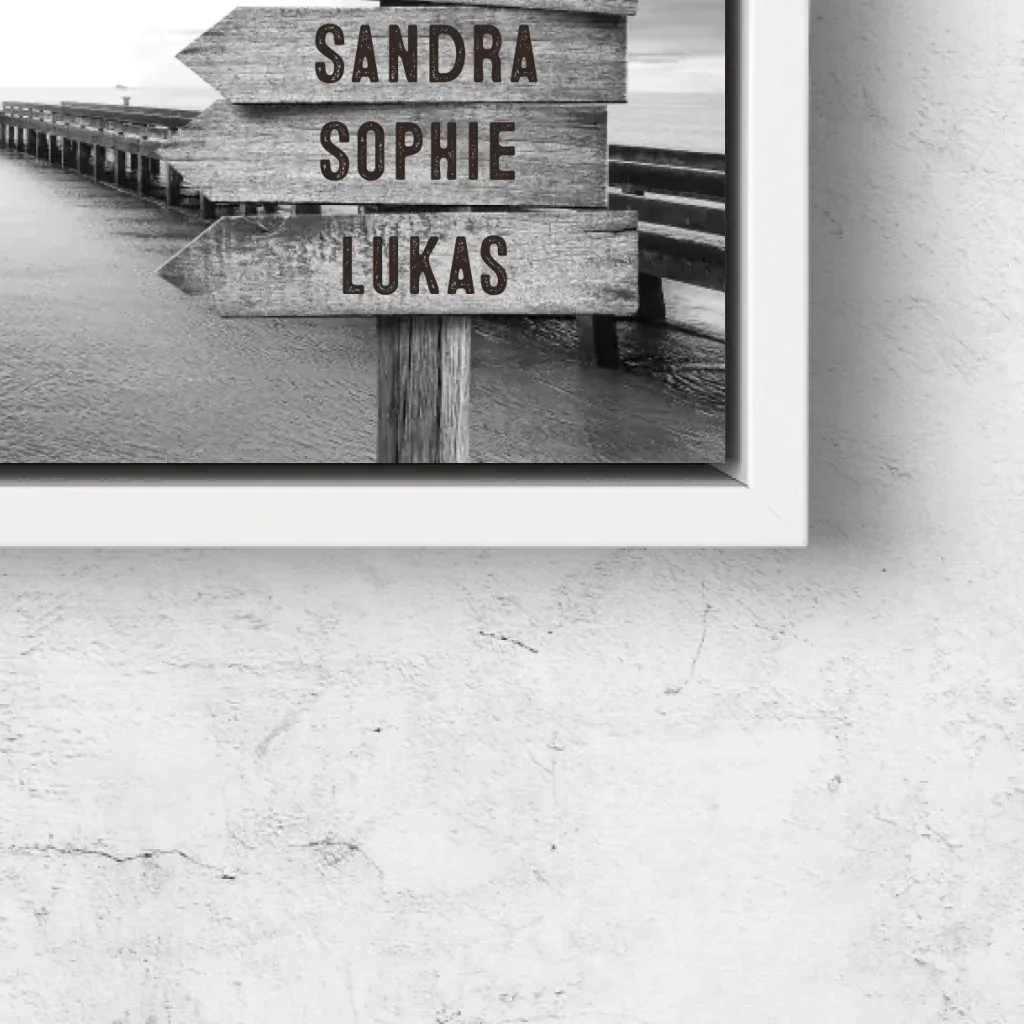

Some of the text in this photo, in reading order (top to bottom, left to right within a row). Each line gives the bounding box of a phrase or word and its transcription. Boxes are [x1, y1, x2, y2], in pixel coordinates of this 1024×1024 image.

[314, 23, 538, 84] SANDRA
[319, 120, 516, 182] SOPHIE
[342, 235, 509, 296] LUKAS
